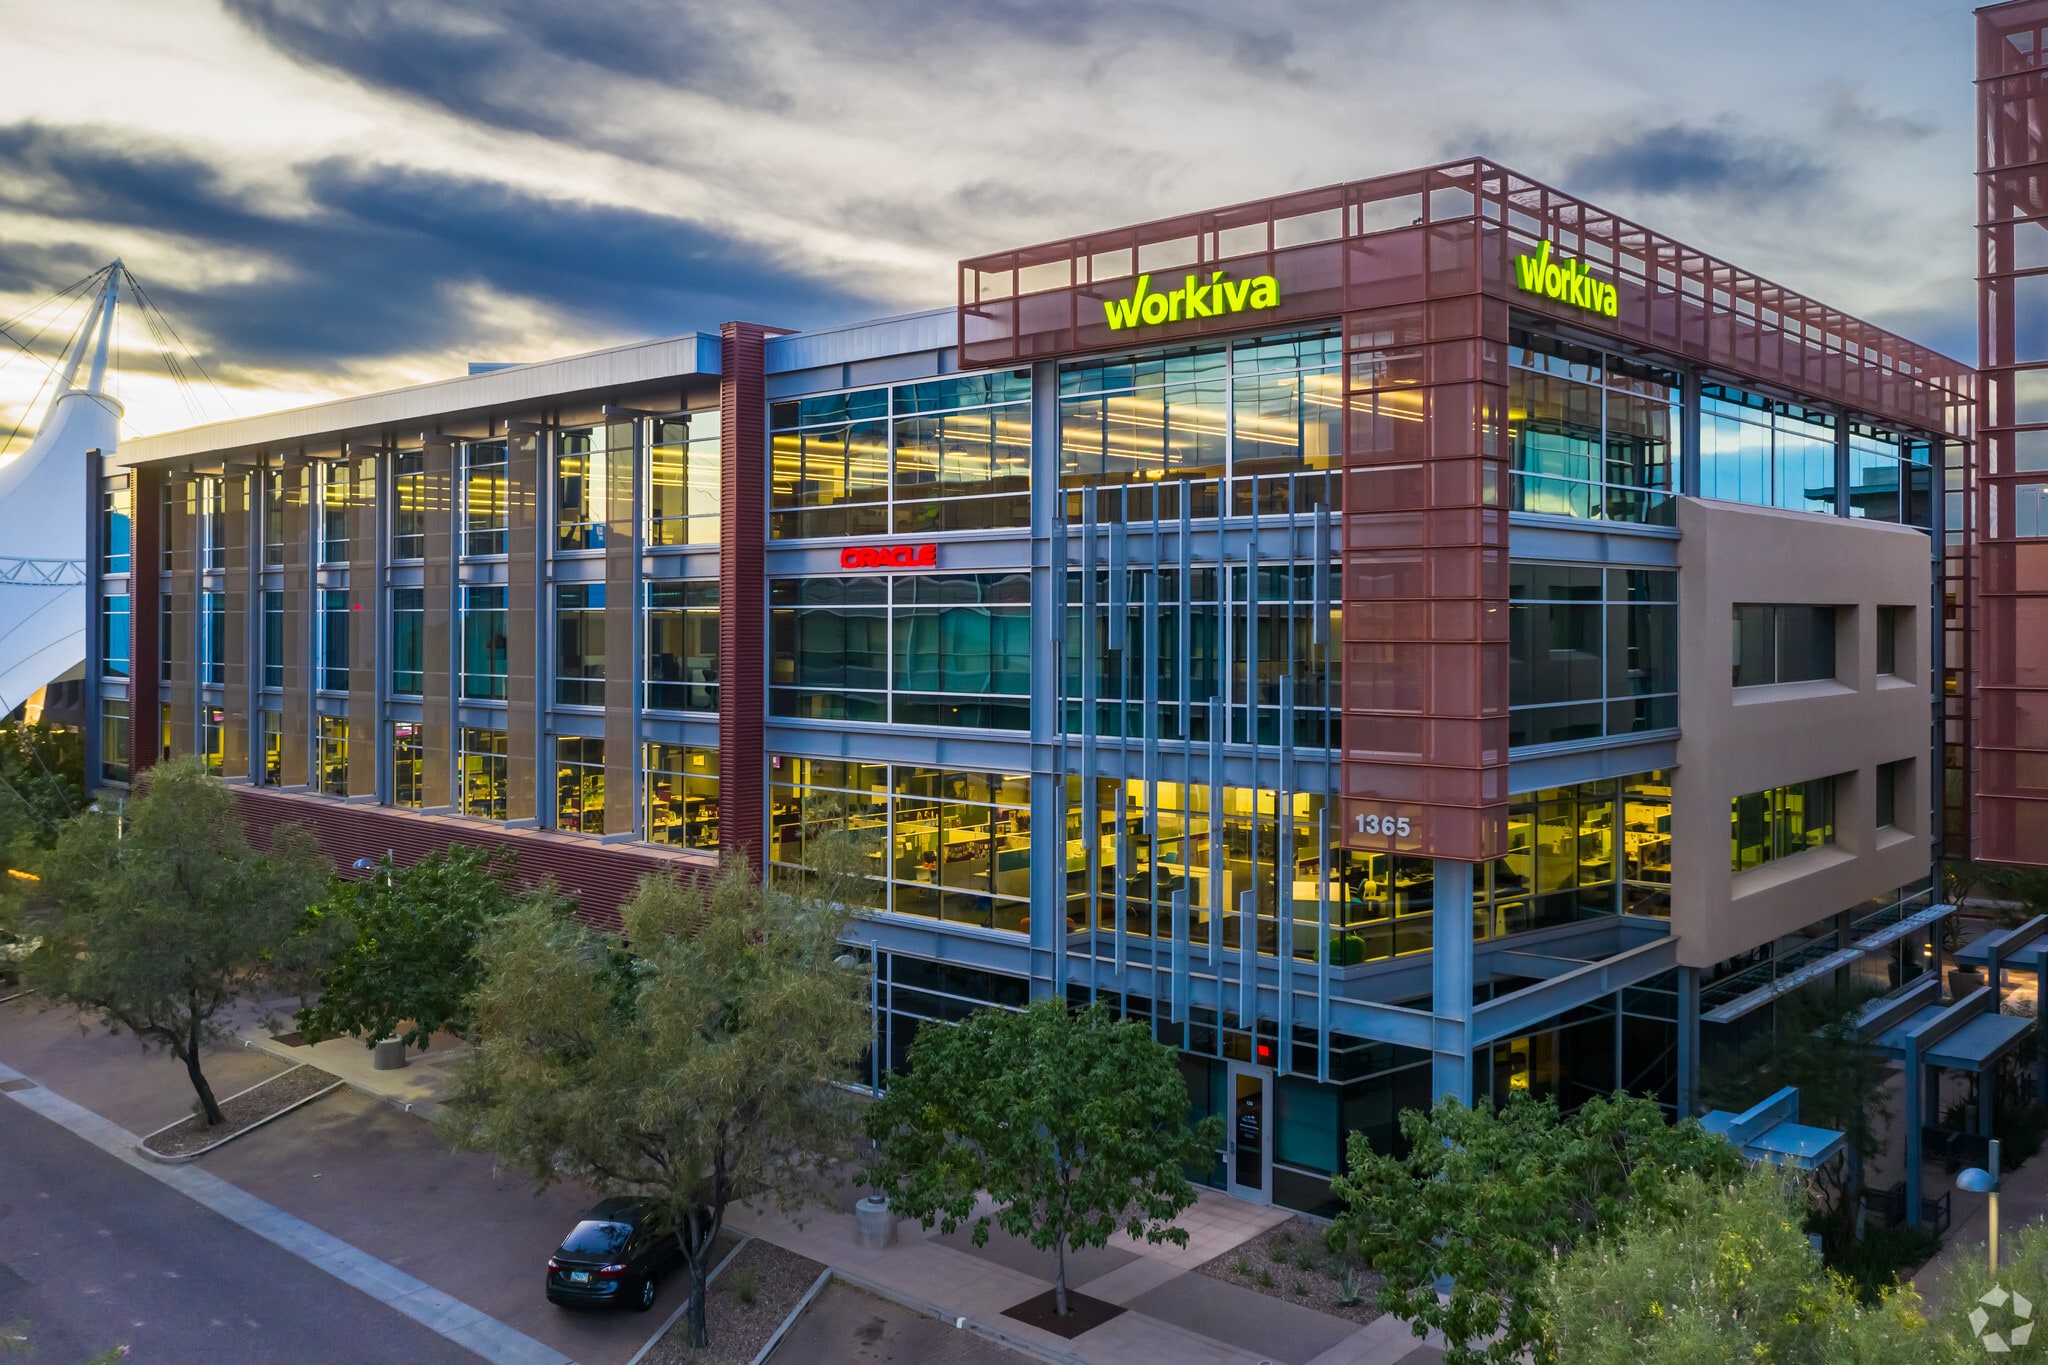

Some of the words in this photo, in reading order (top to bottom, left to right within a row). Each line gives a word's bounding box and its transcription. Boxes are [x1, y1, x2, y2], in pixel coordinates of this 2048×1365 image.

[1514, 240, 1618, 317] Workiva
[1104, 271, 1280, 330] Workiva
[841, 544, 937, 568] ORACLE
[1356, 814, 1410, 837] 1365
